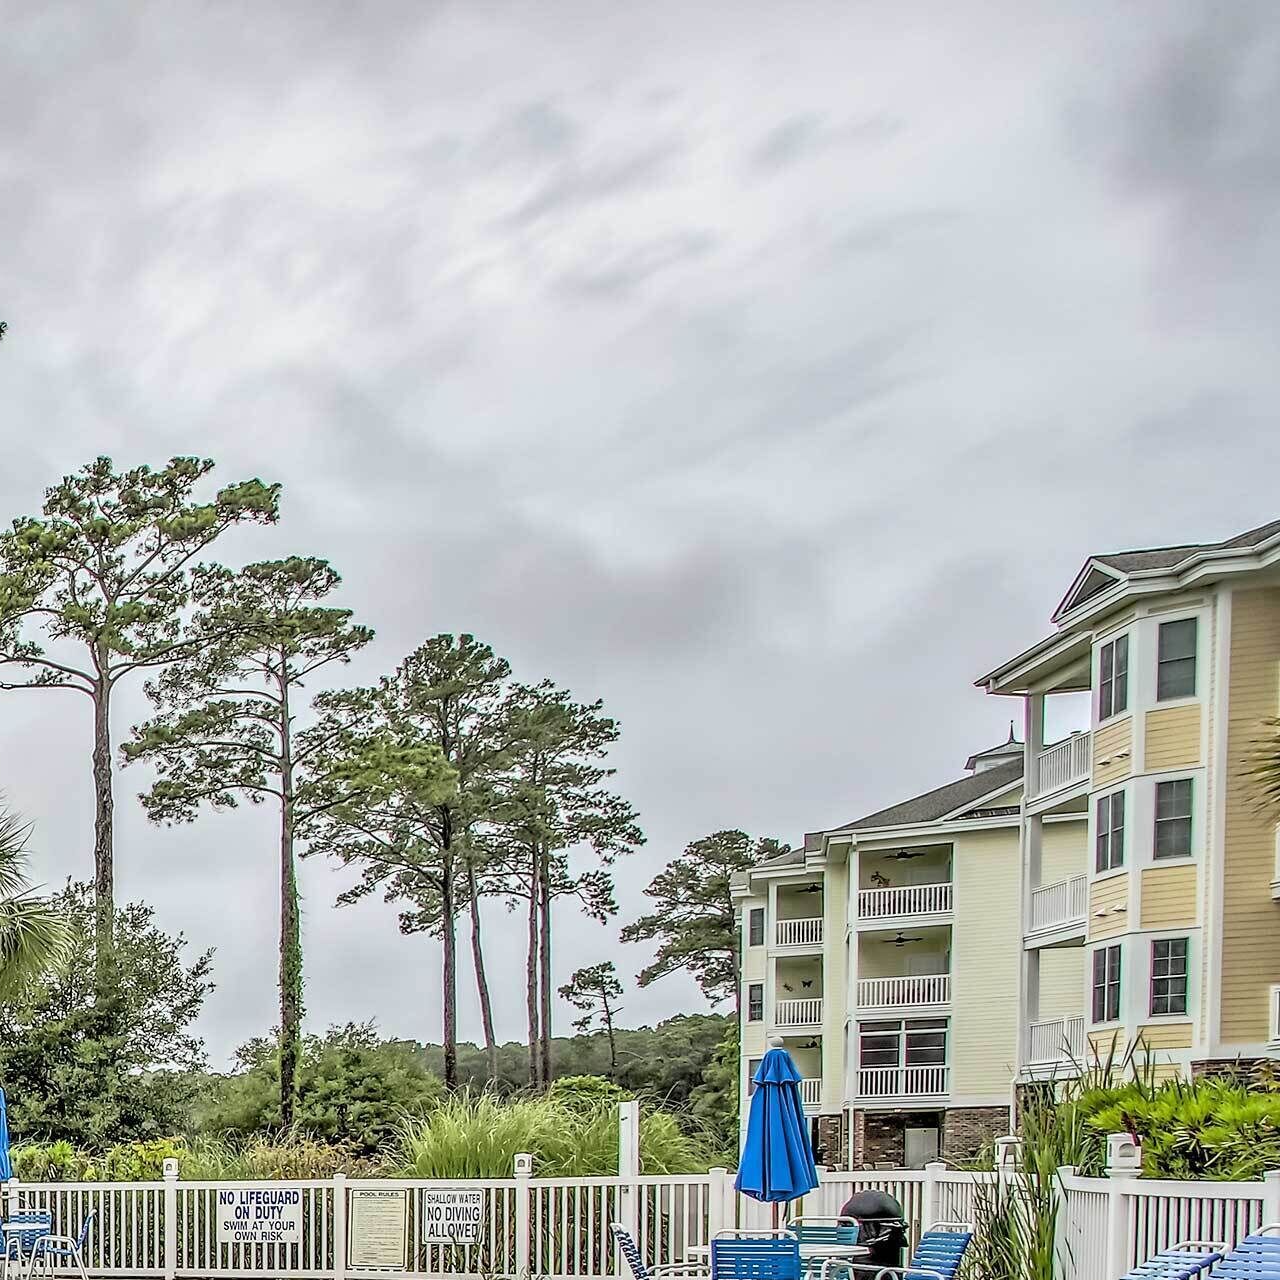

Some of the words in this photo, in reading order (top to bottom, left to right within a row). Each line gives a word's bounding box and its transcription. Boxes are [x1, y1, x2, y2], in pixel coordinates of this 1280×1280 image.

[219, 1191, 235, 1205] NO
[240, 1191, 300, 1205] LIFEGUARD
[428, 1194, 457, 1204] SHALLOW
[459, 1194, 481, 1204] WATER
[235, 1206, 250, 1219] ON
[255, 1206, 284, 1219] DUTY
[427, 1207, 442, 1221] NO
[445, 1207, 480, 1221] DIVING
[223, 1221, 248, 1230] SWIM
[252, 1221, 264, 1230] AT
[269, 1221, 295, 1230] YOUR
[428, 1223, 478, 1237] ALLOWED
[234, 1231, 257, 1241] OWN
[261, 1231, 283, 1241] RISK
